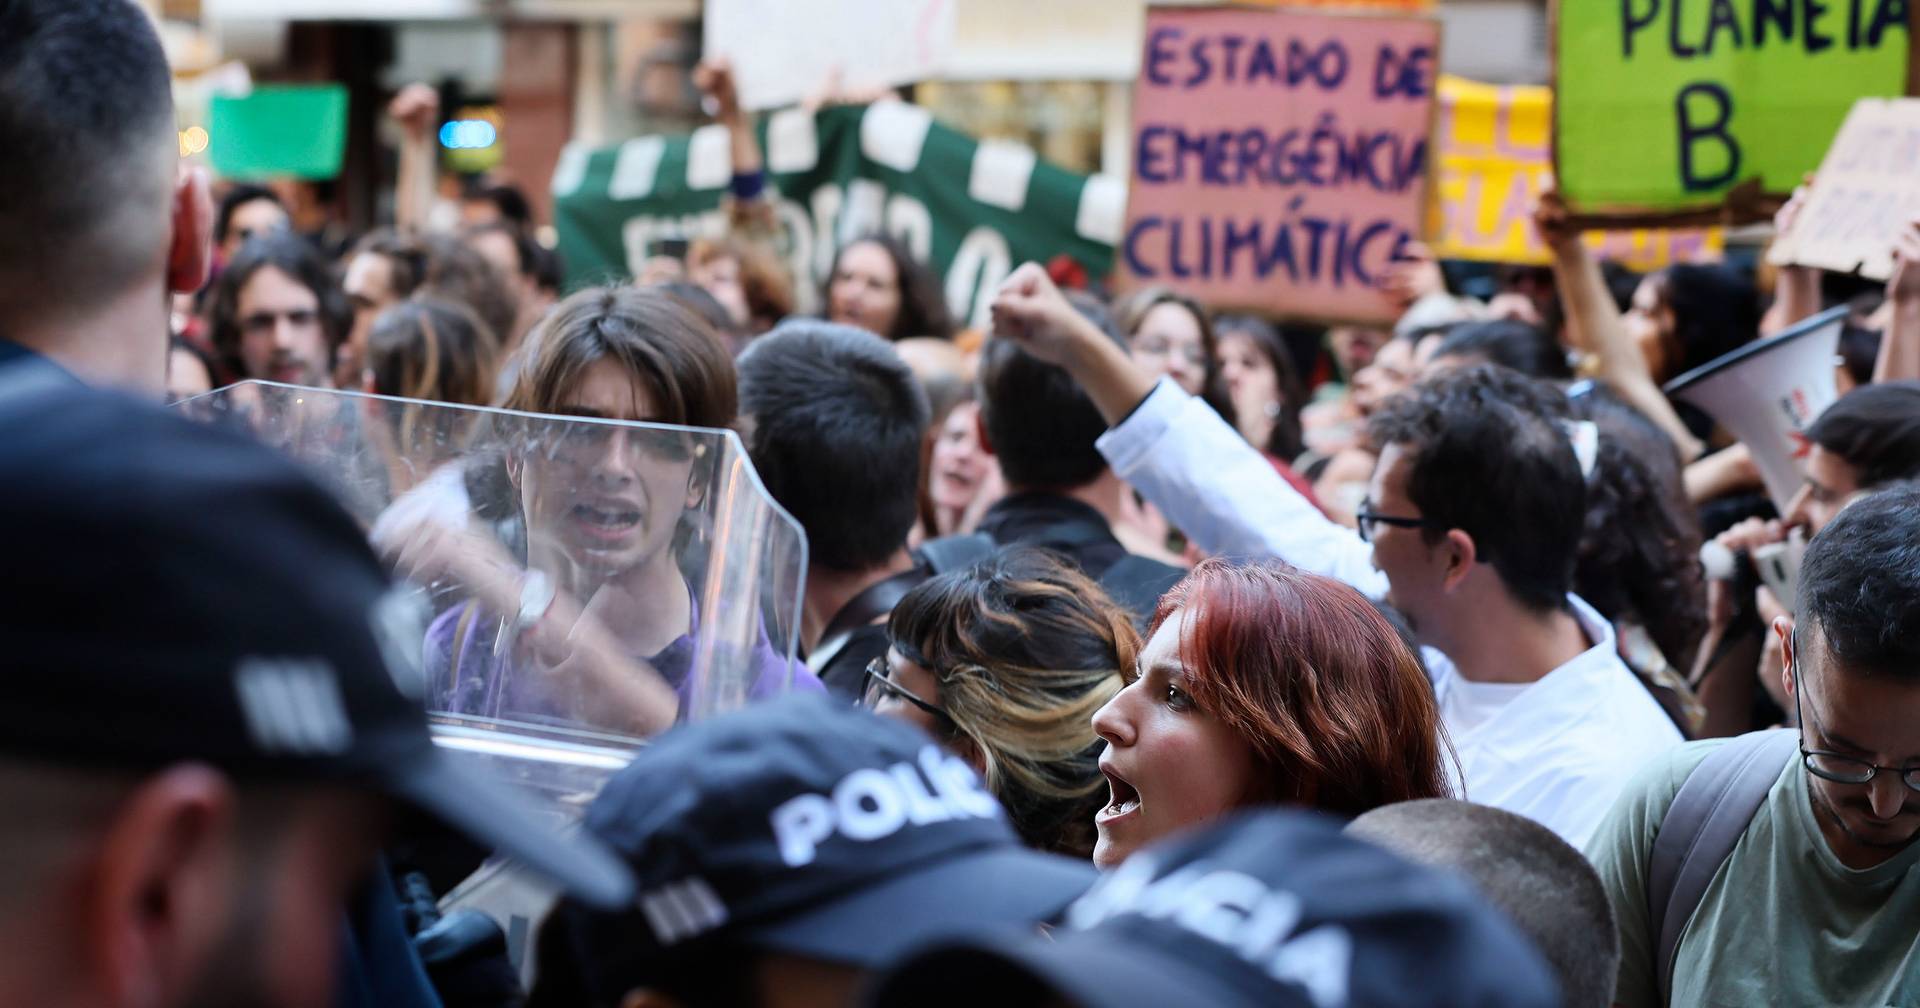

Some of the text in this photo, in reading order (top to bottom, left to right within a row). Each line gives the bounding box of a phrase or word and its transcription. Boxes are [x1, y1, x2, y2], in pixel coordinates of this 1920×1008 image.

[1146, 27, 1434, 99] ESTADO DE
[1675, 80, 1743, 192] B
